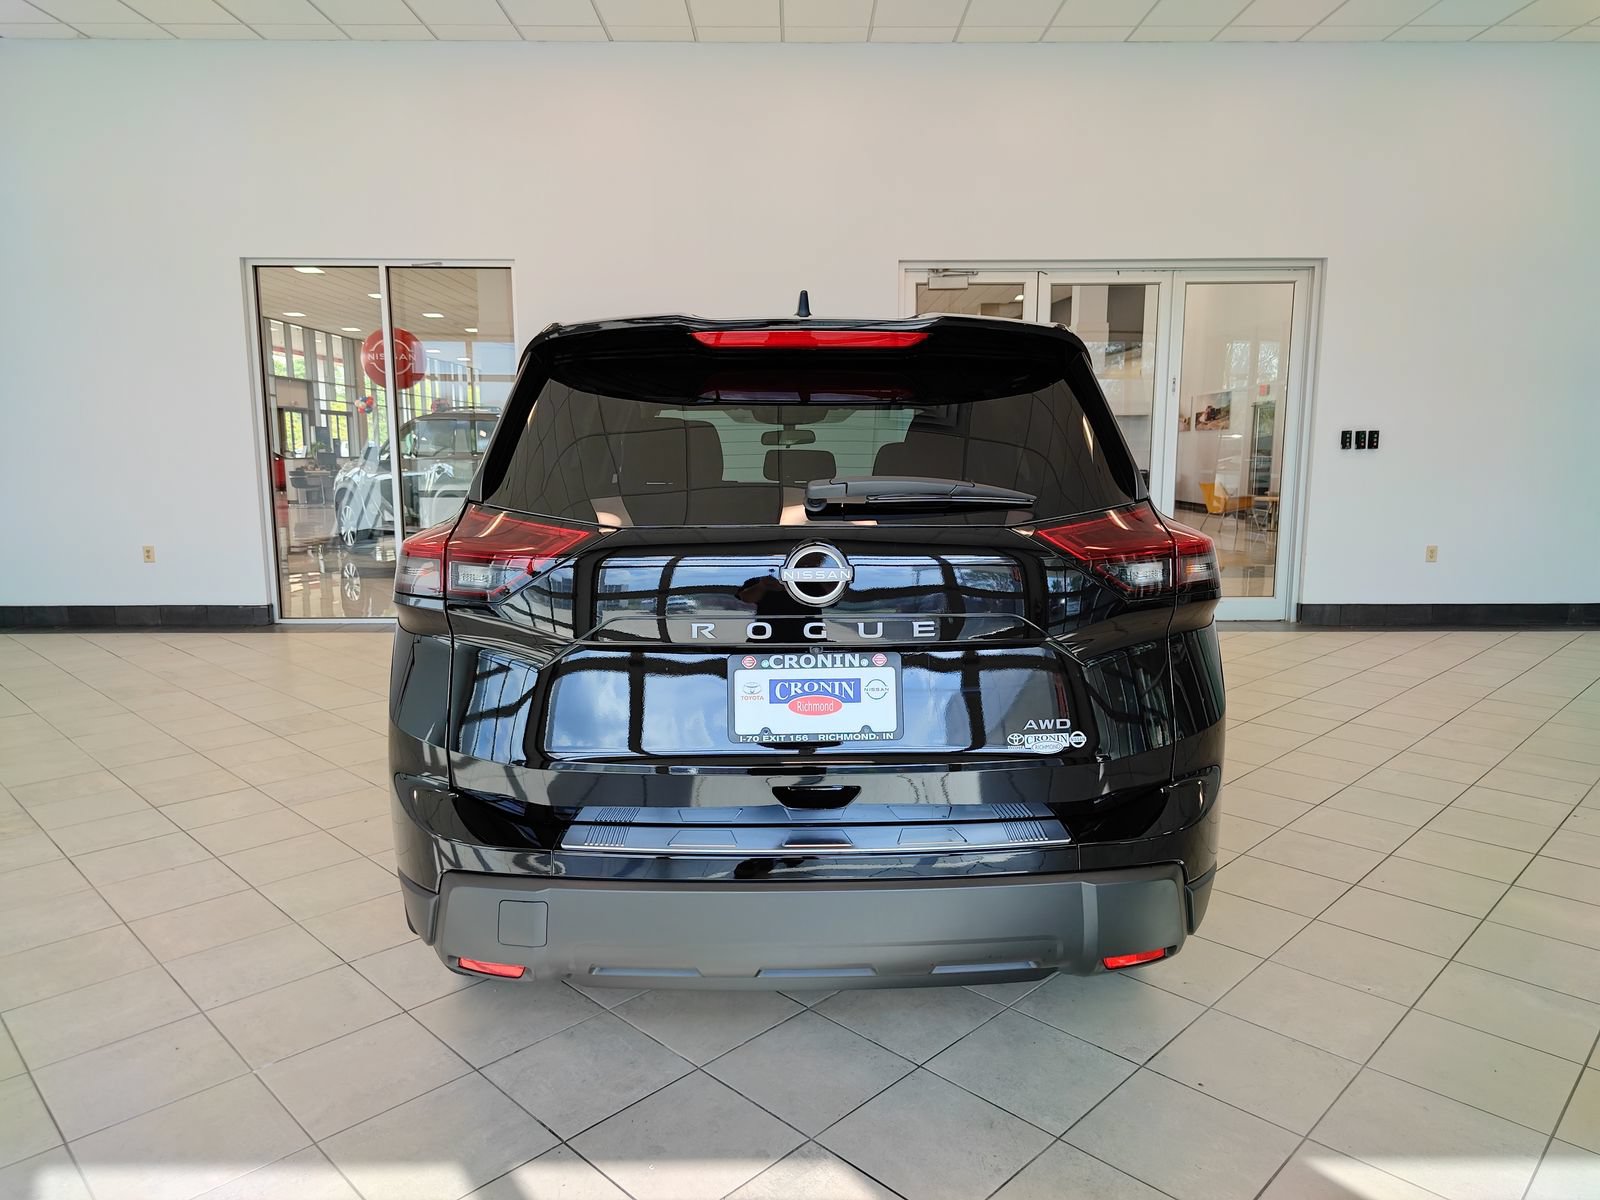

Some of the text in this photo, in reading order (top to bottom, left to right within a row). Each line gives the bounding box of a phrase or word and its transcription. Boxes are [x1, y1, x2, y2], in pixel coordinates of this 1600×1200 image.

[368, 353, 417, 361] NISAN
[783, 570, 850, 580] NISSAN
[691, 621, 937, 639] ROGUE
[769, 653, 860, 669] CRONIN
[775, 681, 855, 700] CRONIN
[796, 700, 834, 712] Richmond
[1023, 719, 1071, 730] AWD
[1026, 735, 1068, 744] CRONIN
